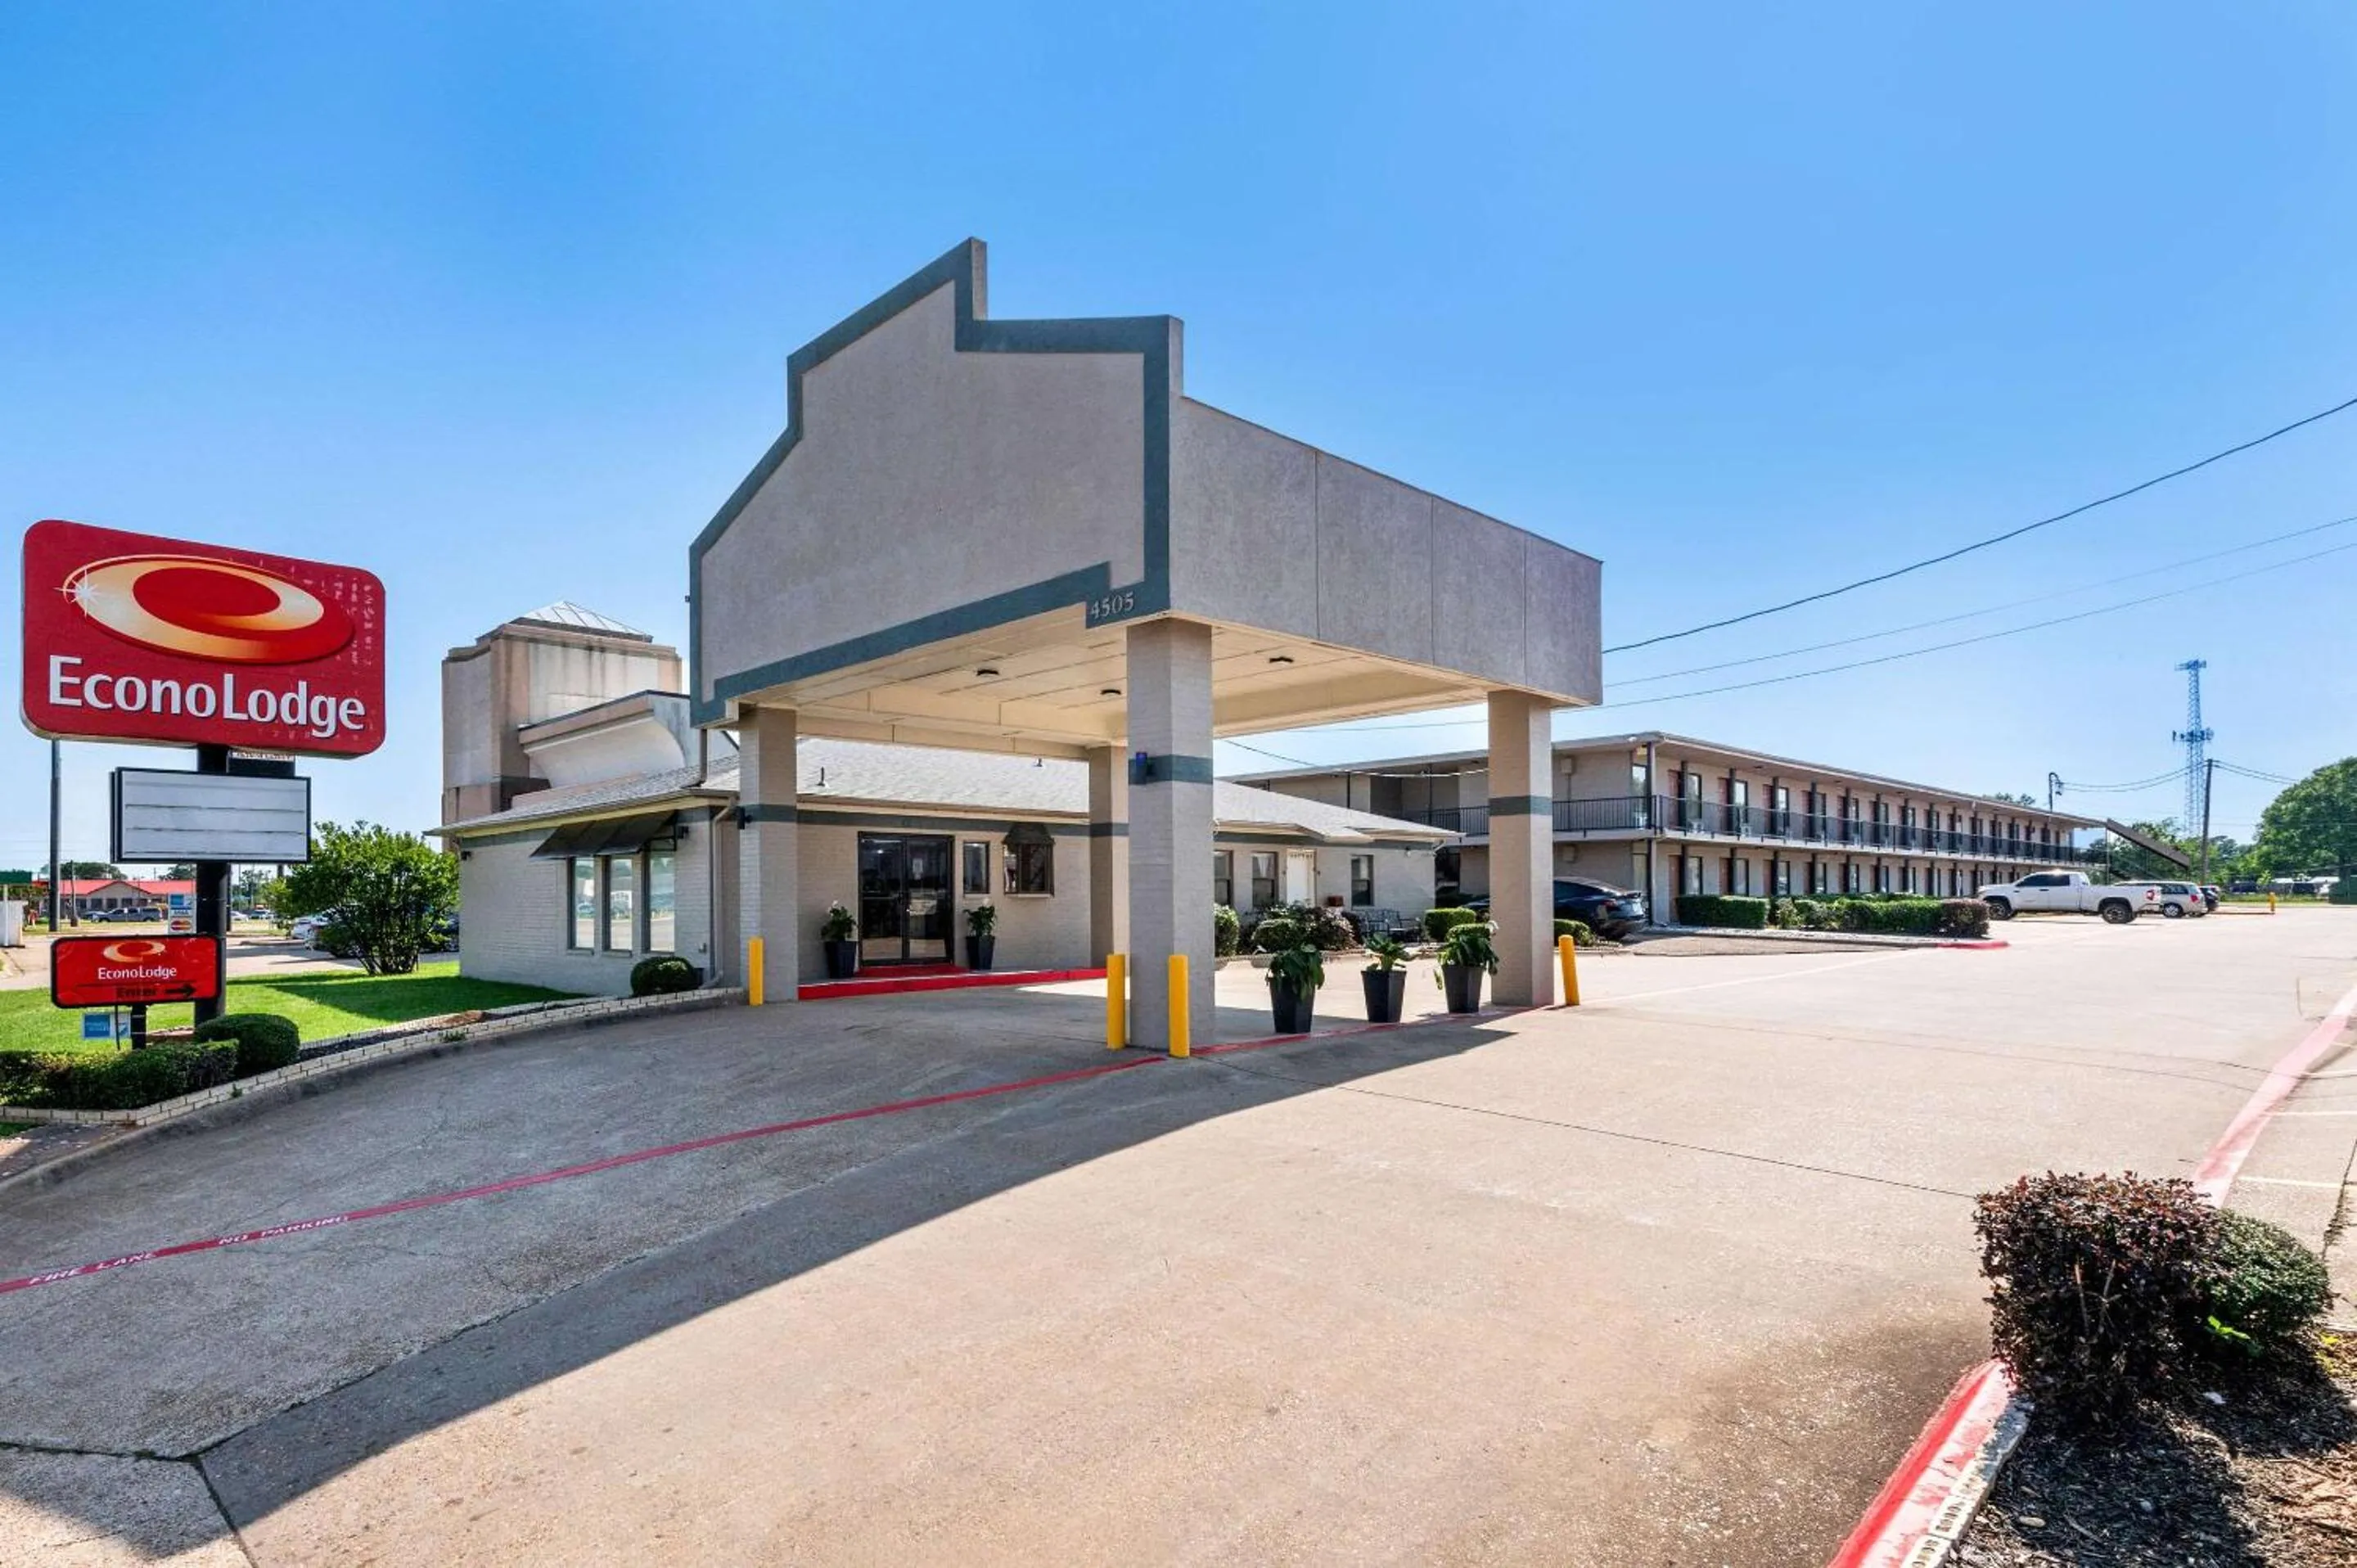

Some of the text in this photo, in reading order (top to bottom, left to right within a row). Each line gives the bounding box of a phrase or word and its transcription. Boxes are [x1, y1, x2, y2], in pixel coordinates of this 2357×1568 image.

[1089, 591, 1134, 620] 4505
[48, 654, 366, 738] EconoLodge
[97, 965, 178, 980] EconoLodge
